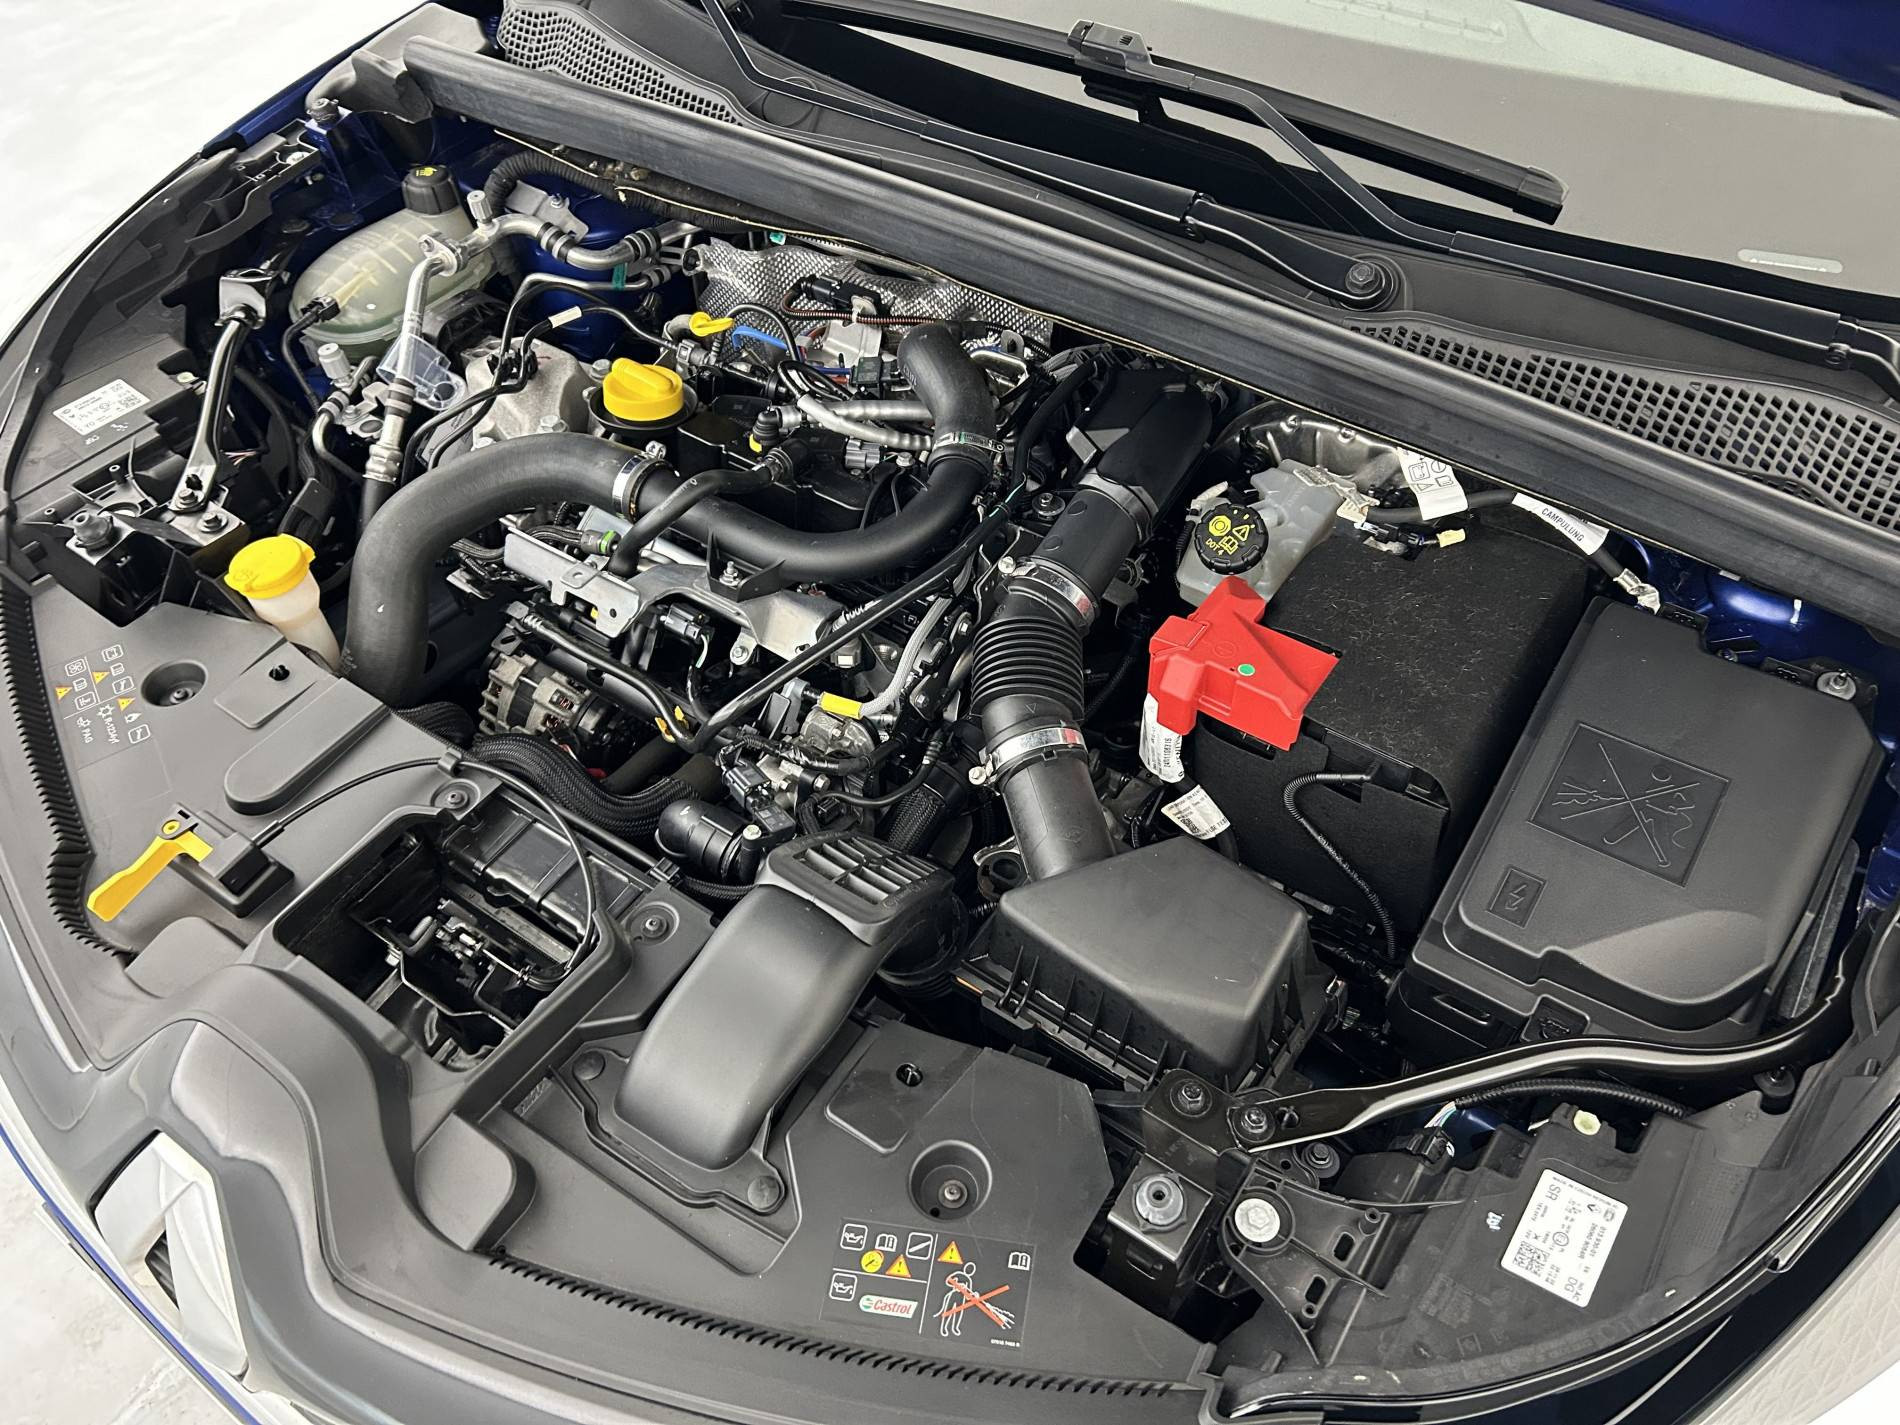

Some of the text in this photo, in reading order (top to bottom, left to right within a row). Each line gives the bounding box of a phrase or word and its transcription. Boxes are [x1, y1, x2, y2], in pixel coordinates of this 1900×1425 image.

[1541, 507, 1584, 542] CAMPULUNG
[1205, 537, 1219, 550] DOT
[81, 728, 93, 743] PAG
[1544, 1182, 1562, 1202] SR
[873, 1299, 911, 1313] Castrol
